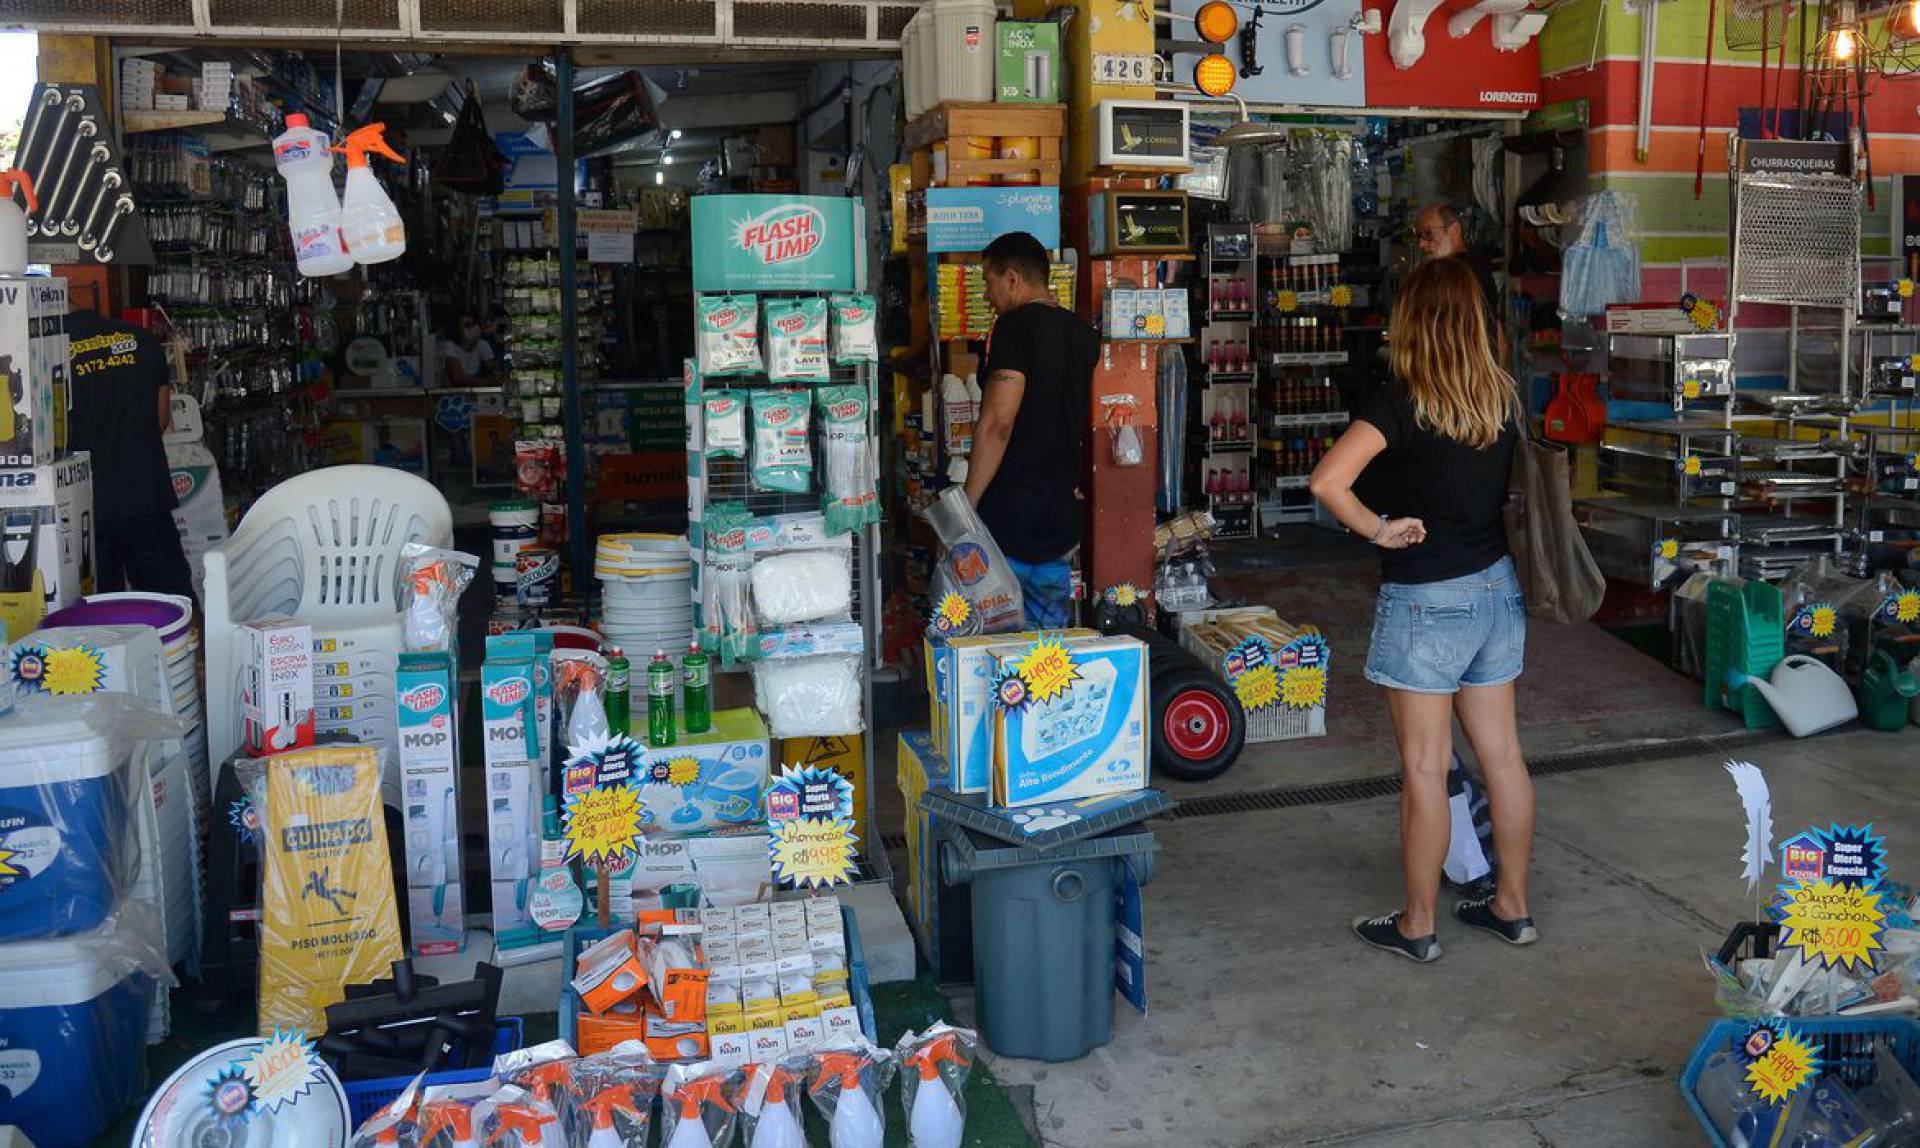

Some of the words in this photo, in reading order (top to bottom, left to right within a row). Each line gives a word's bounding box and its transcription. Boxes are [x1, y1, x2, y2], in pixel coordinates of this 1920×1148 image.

[1009, 40, 1034, 49] INOX
[1104, 58, 1144, 80] 426
[1480, 91, 1537, 104] LORENZETTI
[1751, 156, 1836, 170] CHURRASQUEIRAS
[743, 211, 815, 250] FLASH
[763, 232, 820, 265] LIMP
[708, 307, 738, 323] FLASH
[776, 313, 805, 328] FLASH
[76, 353, 136, 377] 3172-4242
[794, 356, 822, 365] LAVE
[403, 686, 439, 704] FLASH
[489, 680, 526, 696] FLASH
[413, 694, 440, 711] LIMP
[404, 733, 448, 748] MOP
[1019, 775, 1039, 788] Alto
[1041, 749, 1094, 782] Rendimento
[772, 794, 793, 804] BIG
[645, 842, 684, 857] MOP
[1834, 842, 1863, 854] Super
[1789, 850, 1818, 861] BIG
[1832, 854, 1864, 865] Oferta
[1827, 865, 1868, 877] Especial
[291, 938, 318, 950] PISO
[321, 929, 377, 946] MOLHADO
[830, 1016, 851, 1027] kian
[793, 1027, 815, 1039] kian
[719, 1042, 741, 1056] kian
[756, 1037, 779, 1050] kian
